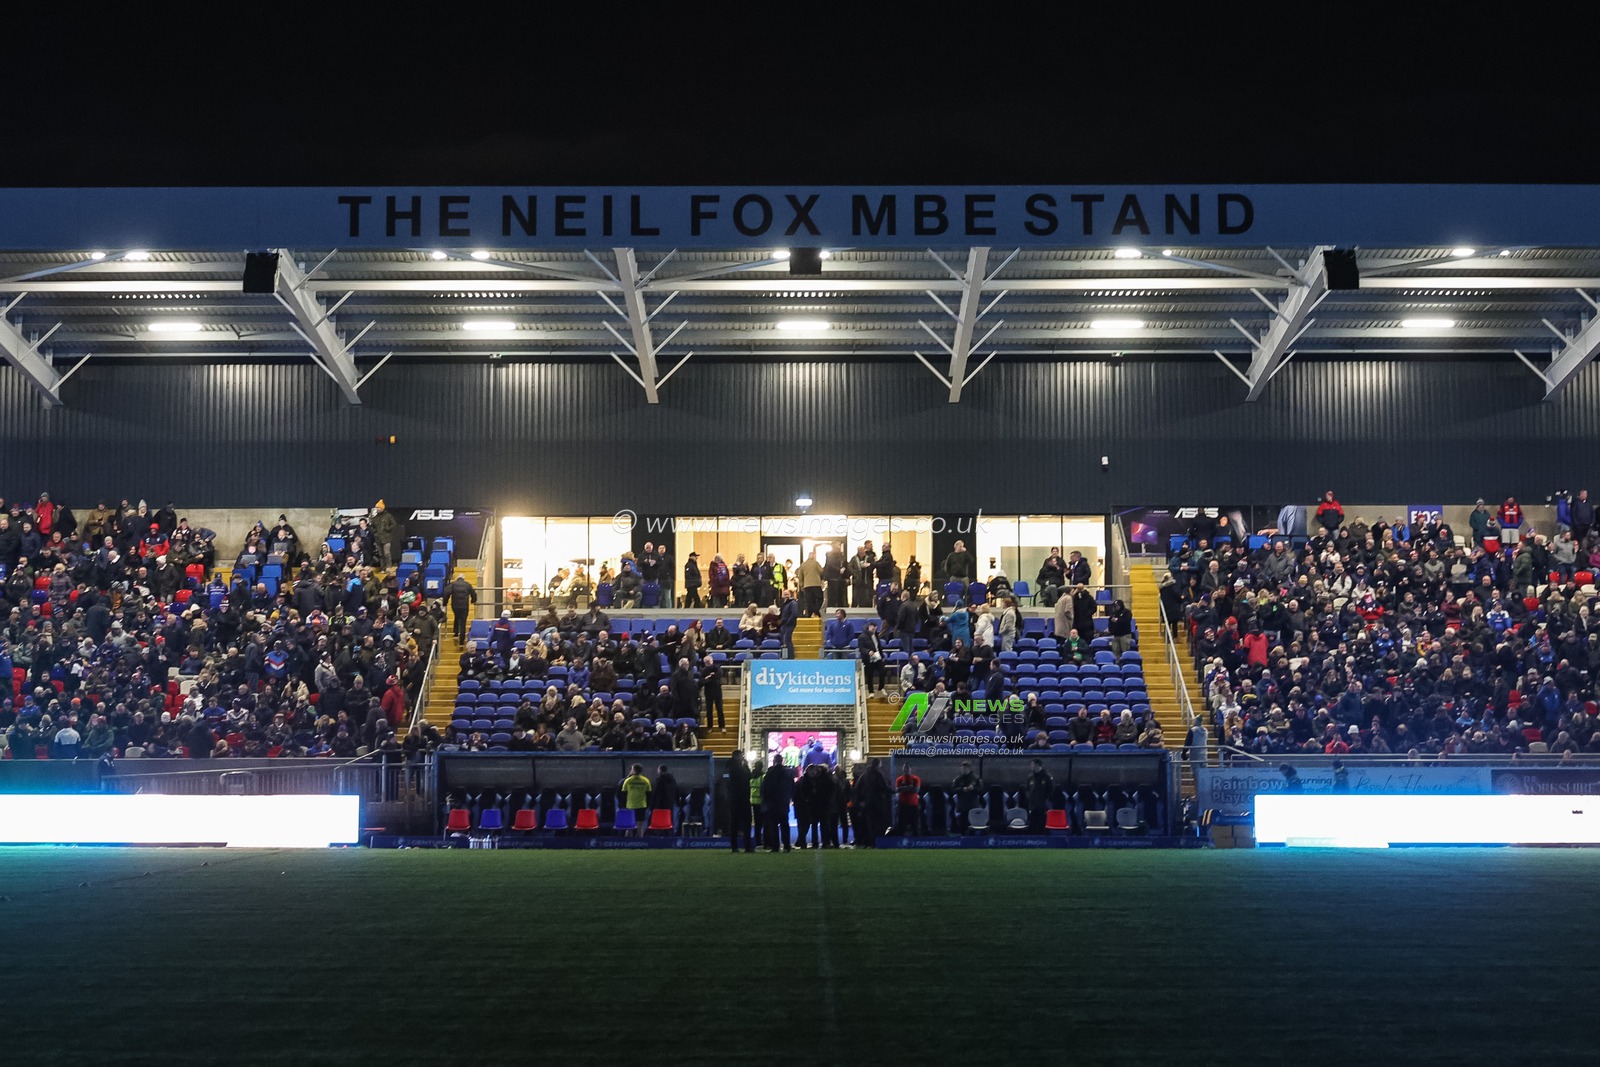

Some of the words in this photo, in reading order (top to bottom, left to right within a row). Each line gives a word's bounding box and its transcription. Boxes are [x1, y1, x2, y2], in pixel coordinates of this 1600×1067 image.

[338, 195, 471, 237] THE
[501, 194, 661, 237] NEIL
[690, 193, 822, 237] FOX
[851, 193, 997, 236] MBE
[1023, 193, 1255, 236] STAND
[409, 509, 454, 520] ASUS
[1174, 507, 1219, 518] ASS
[755, 667, 852, 689] diykitchens
[1211, 776, 1284, 790] Rainbow
